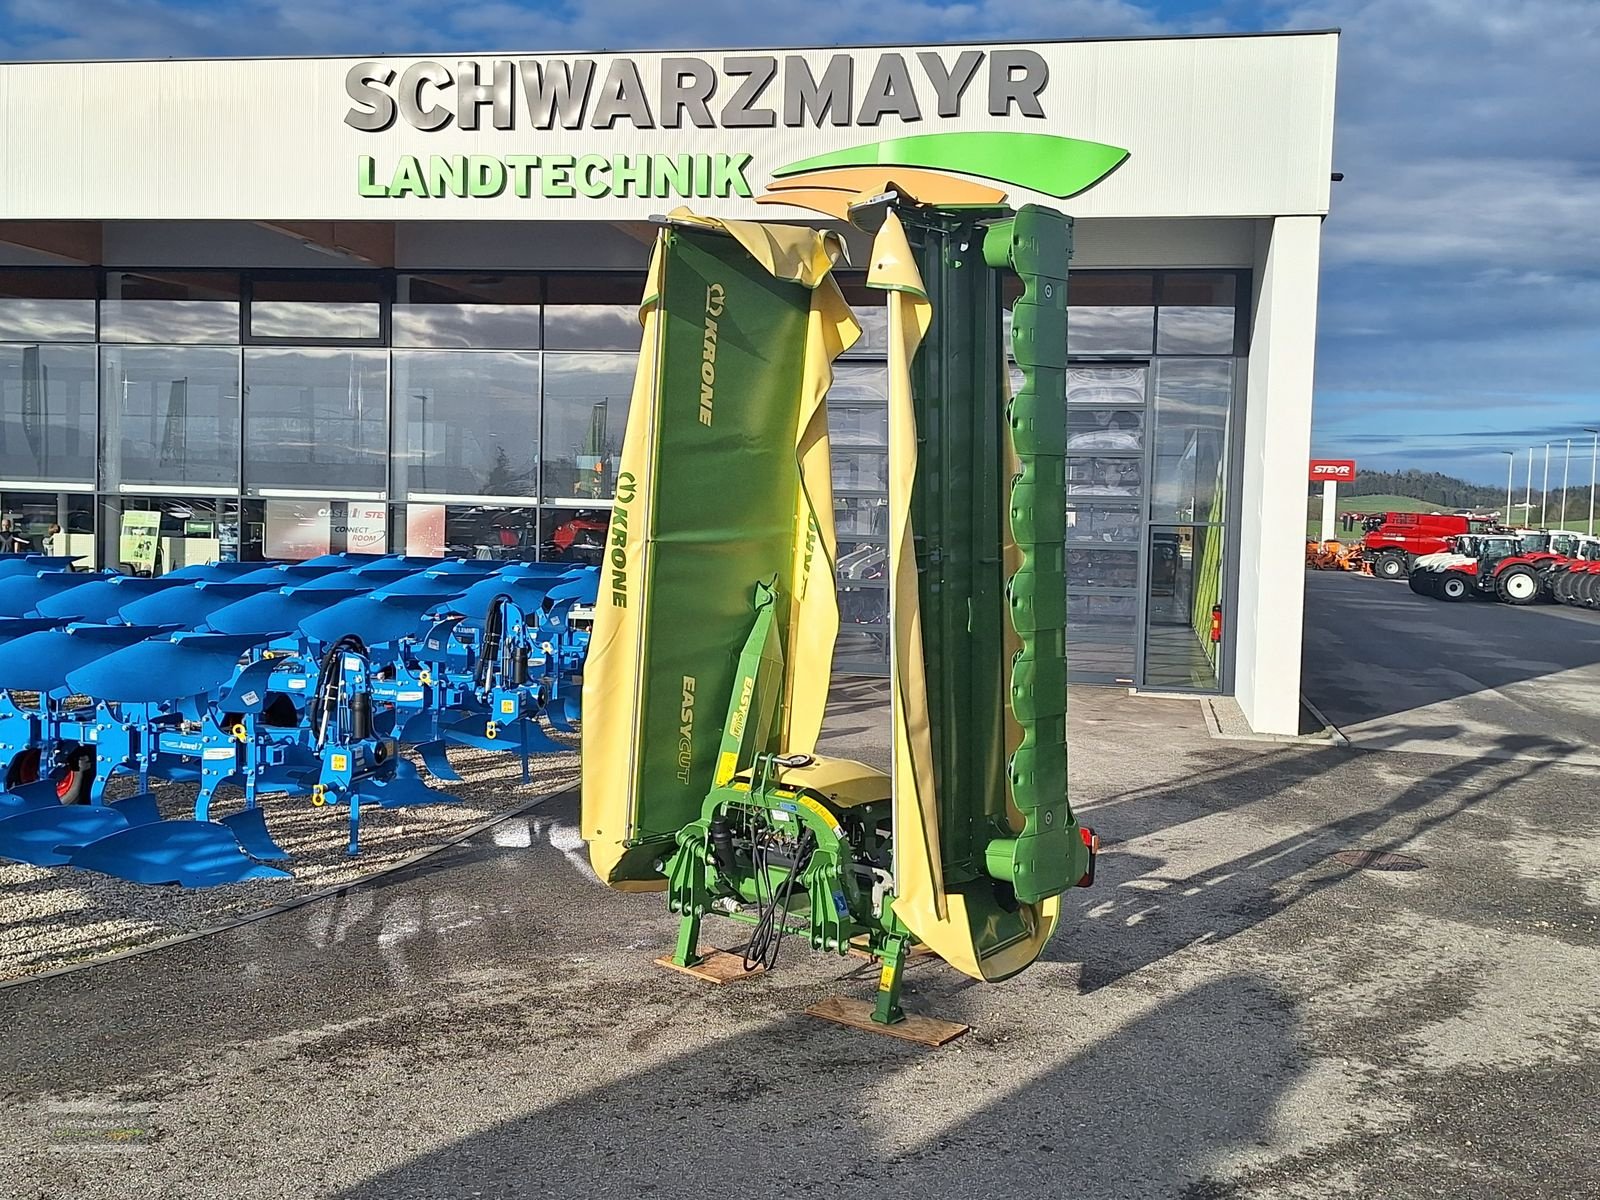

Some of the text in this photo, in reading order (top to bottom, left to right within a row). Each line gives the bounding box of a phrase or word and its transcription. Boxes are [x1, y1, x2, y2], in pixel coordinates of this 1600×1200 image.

[344, 50, 1048, 131] SCHWARZMAYR
[358, 154, 754, 198] LANDTECHNIK
[699, 317, 717, 427] KRONE
[1313, 465, 1350, 476] STEYR
[335, 526, 369, 534] CONNECT
[352, 534, 377, 542] ROOM
[611, 506, 628, 608] KRONE
[677, 675, 696, 785] EASYCUT
